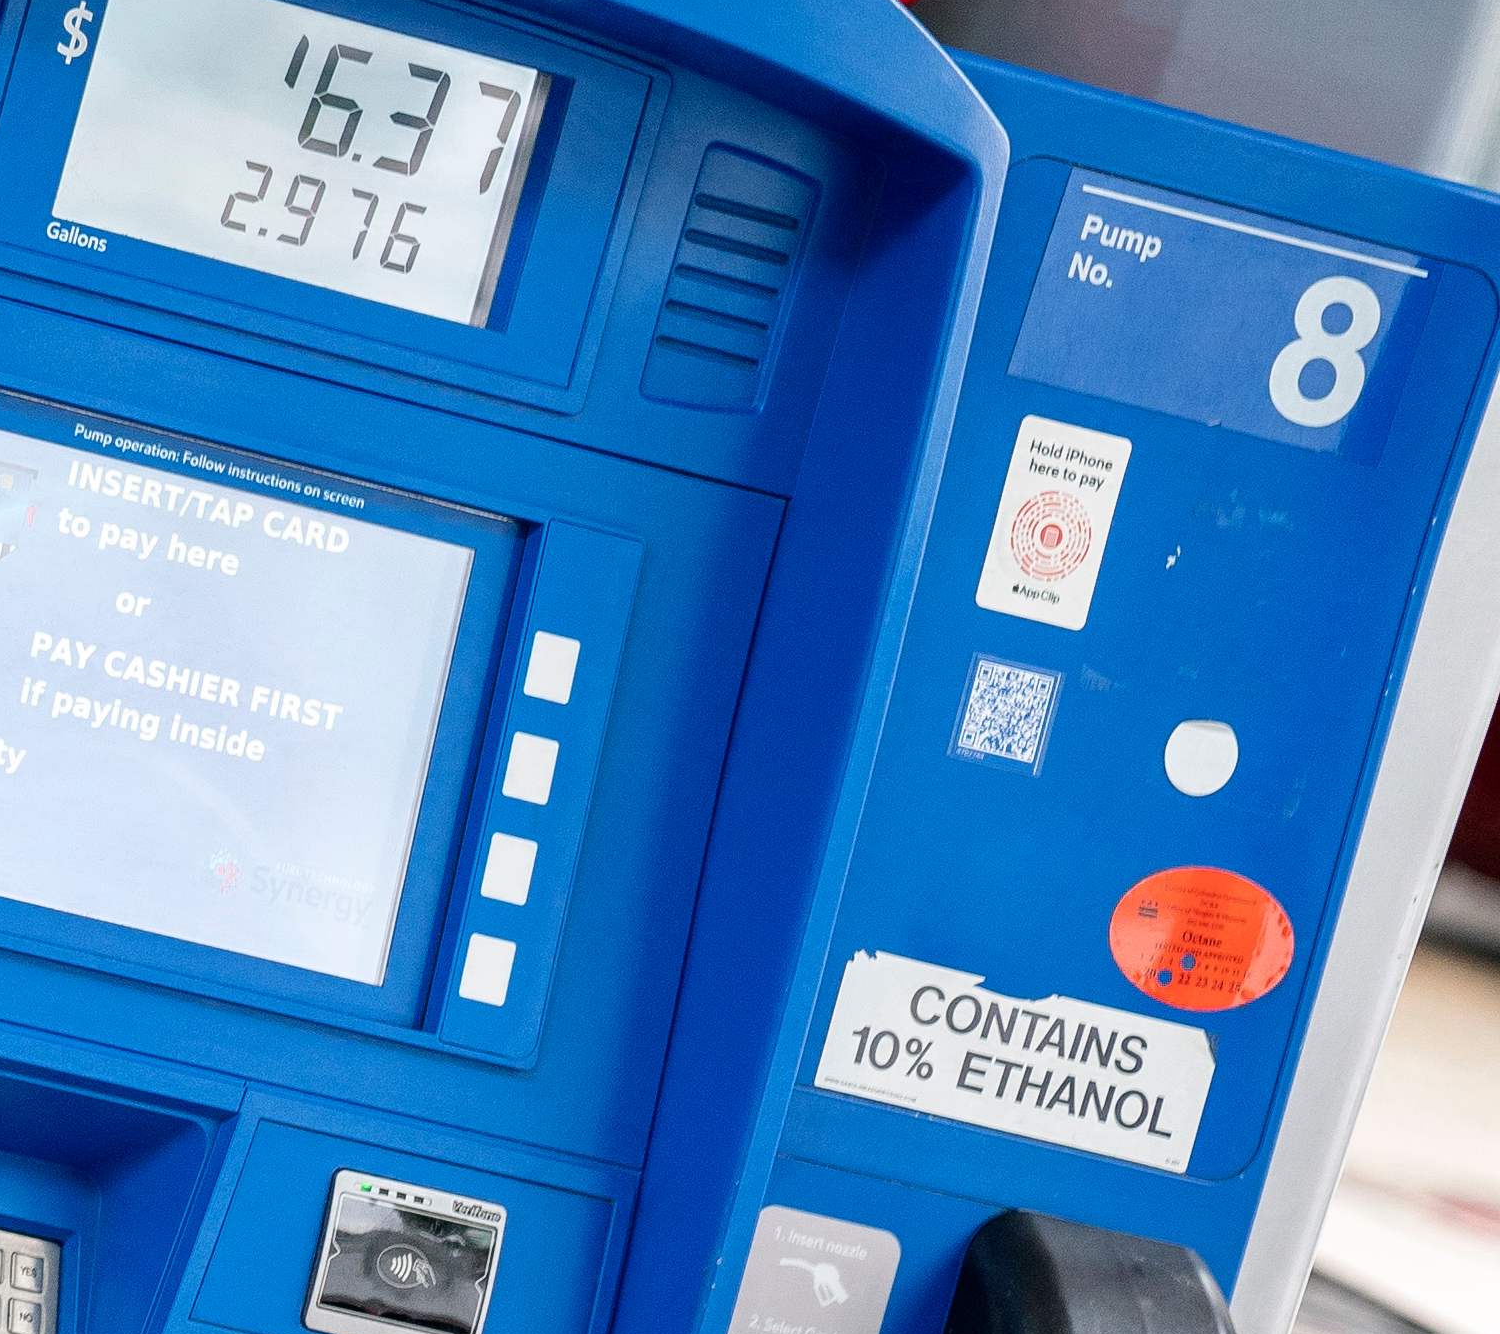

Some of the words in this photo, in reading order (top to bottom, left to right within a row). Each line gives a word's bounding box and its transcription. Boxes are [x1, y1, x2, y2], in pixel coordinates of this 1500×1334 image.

[283, 34, 522, 194] 16.37
[46, 221, 106, 251] Gallons
[221, 160, 427, 273] 2.976
[1080, 214, 1161, 262] Pump
[1068, 252, 1112, 287] No.
[1269, 275, 1381, 428] 8
[74, 423, 112, 447] Pump
[114, 437, 179, 462] operation:
[182, 450, 225, 473] Follow
[228, 462, 300, 492] instructions
[303, 485, 320, 497] on
[323, 490, 364, 508] screen
[1029, 439, 1063, 458] Hold
[1065, 448, 1112, 470] iPhone
[1029, 457, 1059, 477] here
[1063, 468, 1076, 481] to
[1079, 474, 1104, 491] pay
[58, 507, 90, 537] to
[98, 523, 158, 559] pay
[167, 533, 238, 575] here
[68, 461, 260, 531] INSERT/TAP
[263, 511, 351, 552] CARD
[115, 592, 150, 616] or
[20, 677, 46, 706] if
[51, 691, 159, 740] paying
[170, 714, 264, 760] inside
[31, 633, 95, 670] PAY
[104, 650, 241, 708] CASHIER
[251, 685, 344, 730] FIRST
[910, 985, 1147, 1074] CONTAINS
[853, 1026, 933, 1079] 10%
[956, 1051, 1171, 1138] ETHANOL
